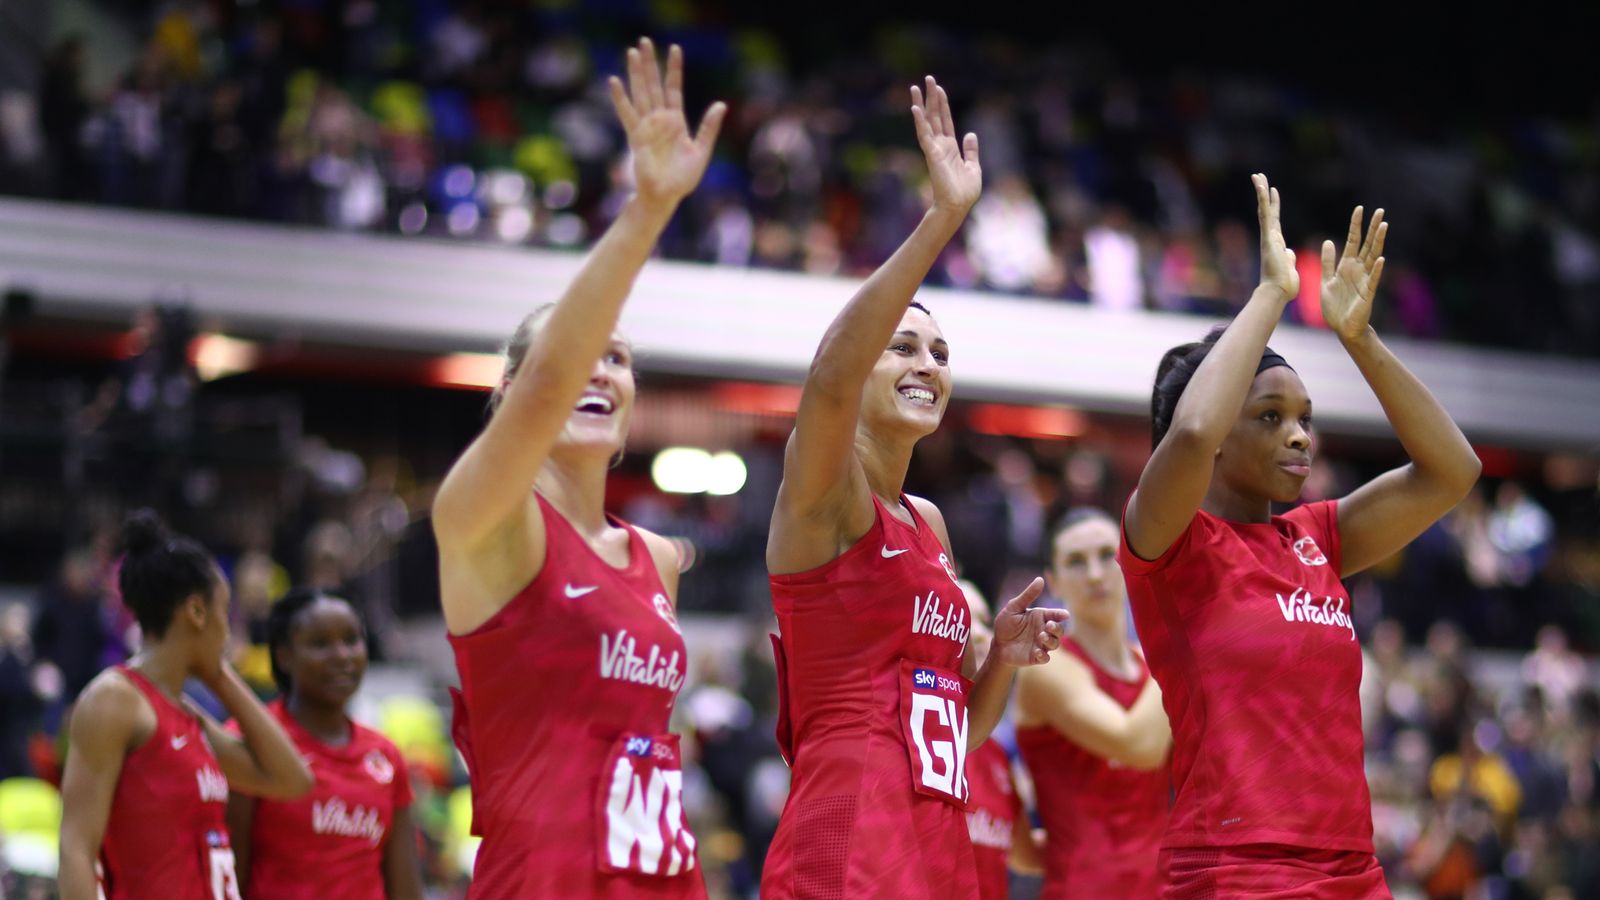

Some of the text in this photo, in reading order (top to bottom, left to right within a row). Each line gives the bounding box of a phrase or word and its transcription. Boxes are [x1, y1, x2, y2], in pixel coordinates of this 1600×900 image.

[912, 591, 969, 658] Vitality
[1276, 587, 1355, 641] Vitality
[601, 629, 684, 708] Vitality
[915, 670, 936, 688] sky
[910, 692, 968, 804] GK
